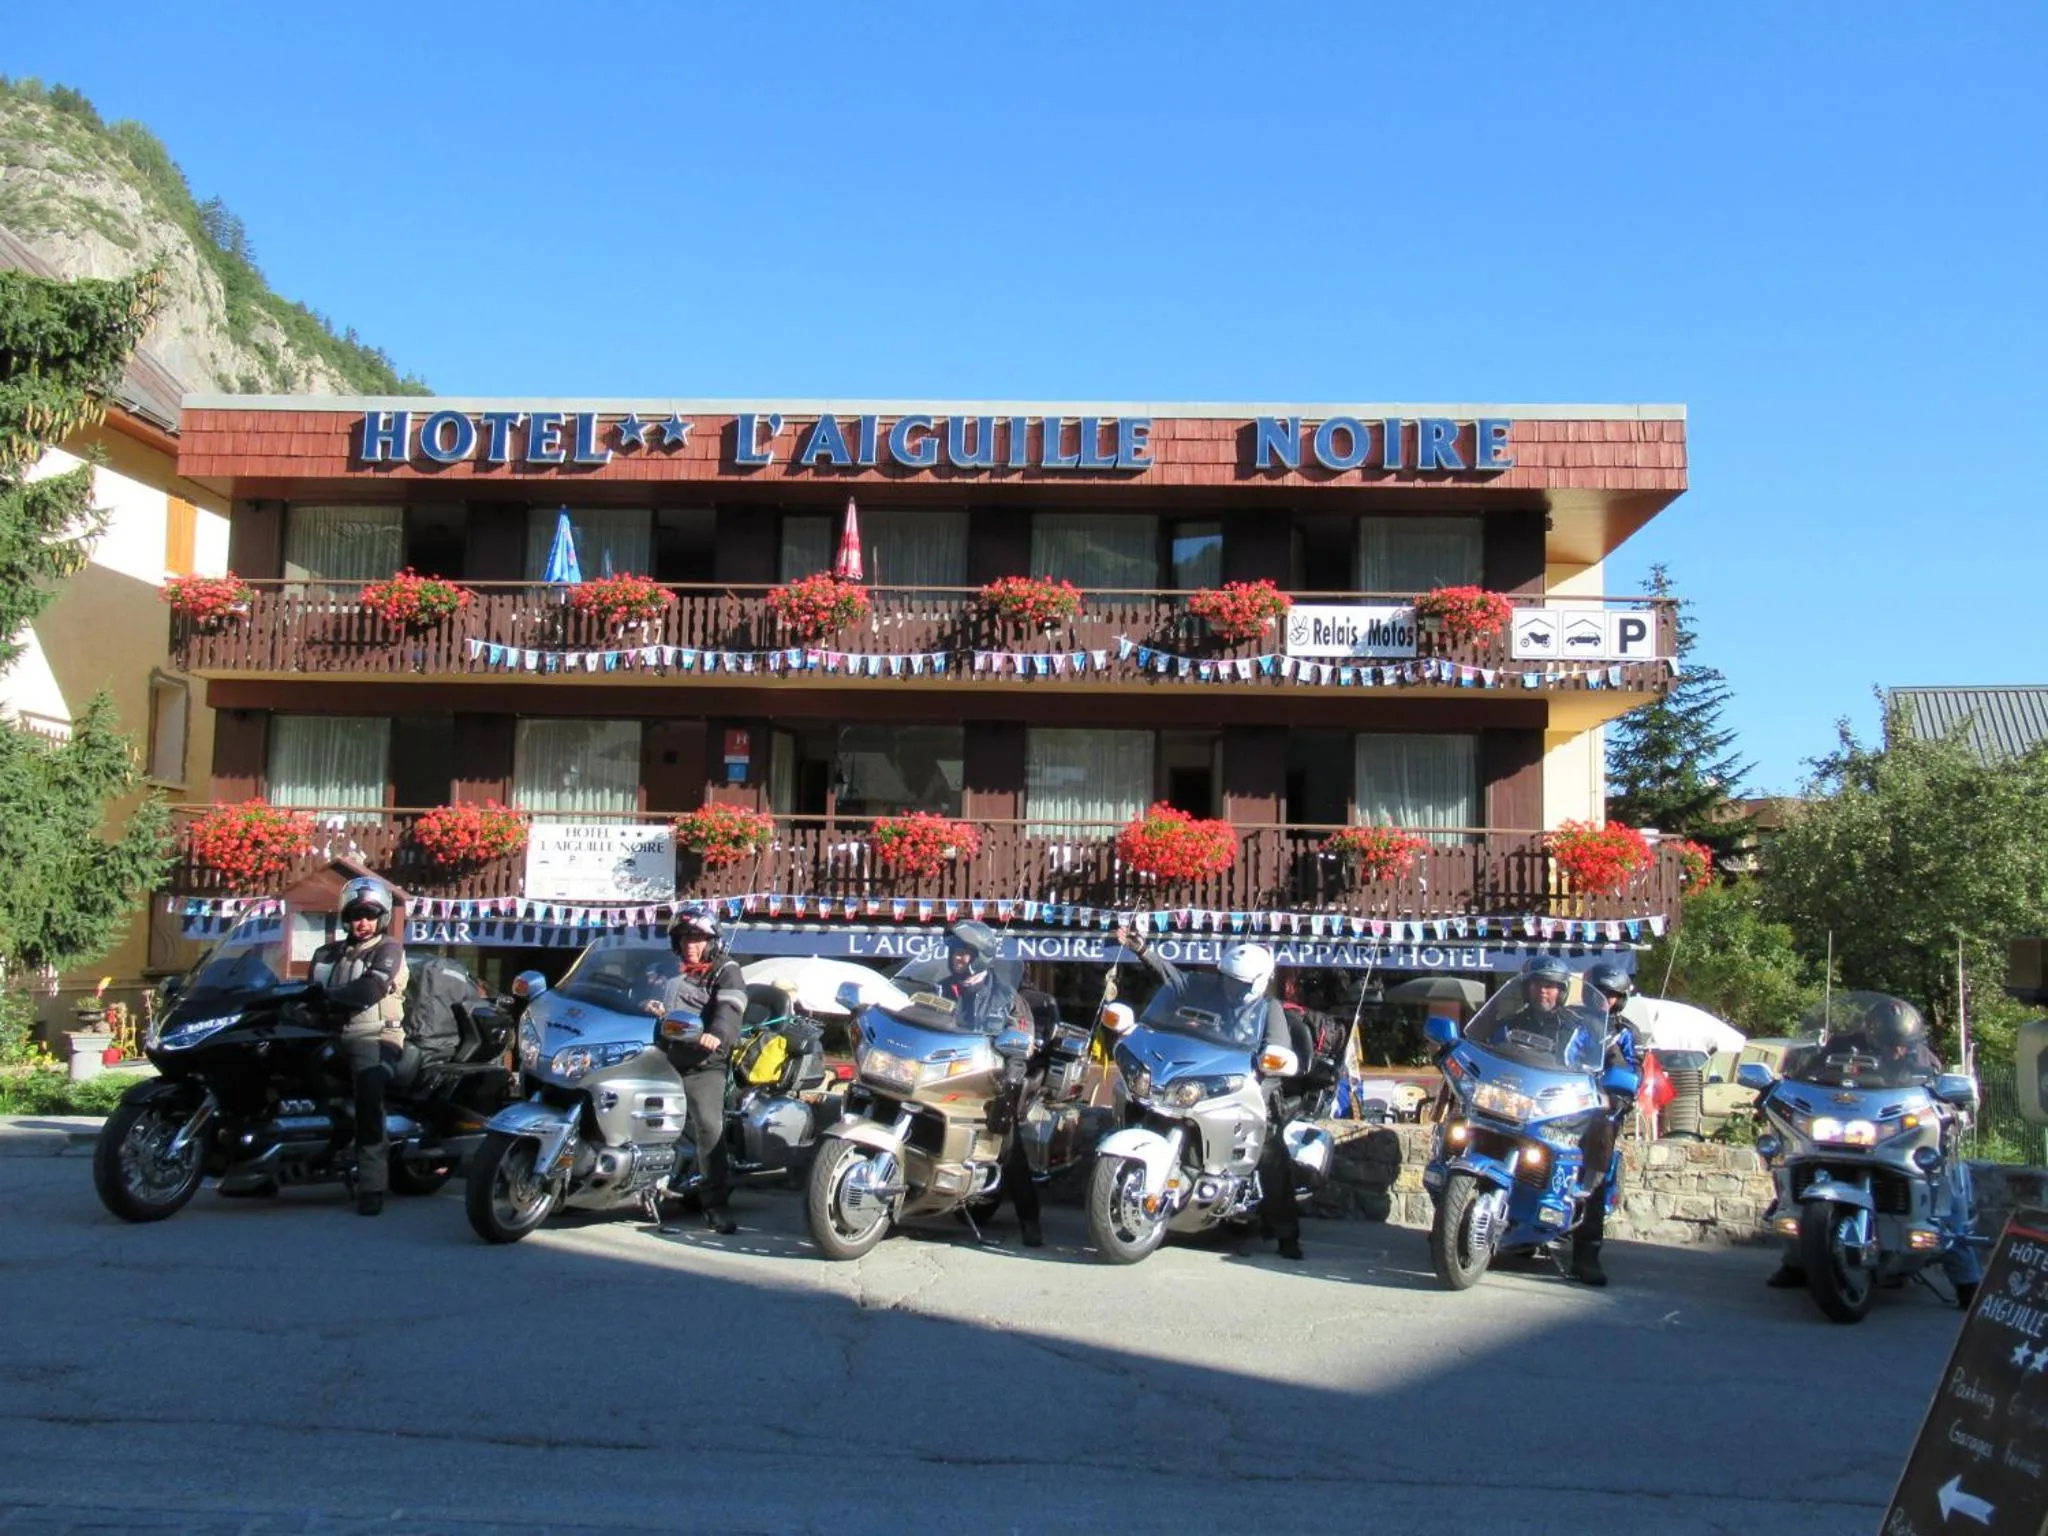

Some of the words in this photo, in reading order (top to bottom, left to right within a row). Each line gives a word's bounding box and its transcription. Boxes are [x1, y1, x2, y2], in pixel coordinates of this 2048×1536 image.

[361, 411, 612, 463] HOTEL
[735, 413, 1153, 469] L'AIGUILLE
[1256, 416, 1513, 470] NOIRE
[1313, 616, 1359, 646] Relais
[1367, 618, 1414, 647] Motos
[1619, 618, 1647, 654] P
[565, 827, 610, 839] HOTEL
[541, 840, 613, 852] LAIGUILLE
[621, 841, 665, 854] NOIRE
[411, 921, 473, 942] BAR
[1017, 937, 1104, 958] NOIRE
